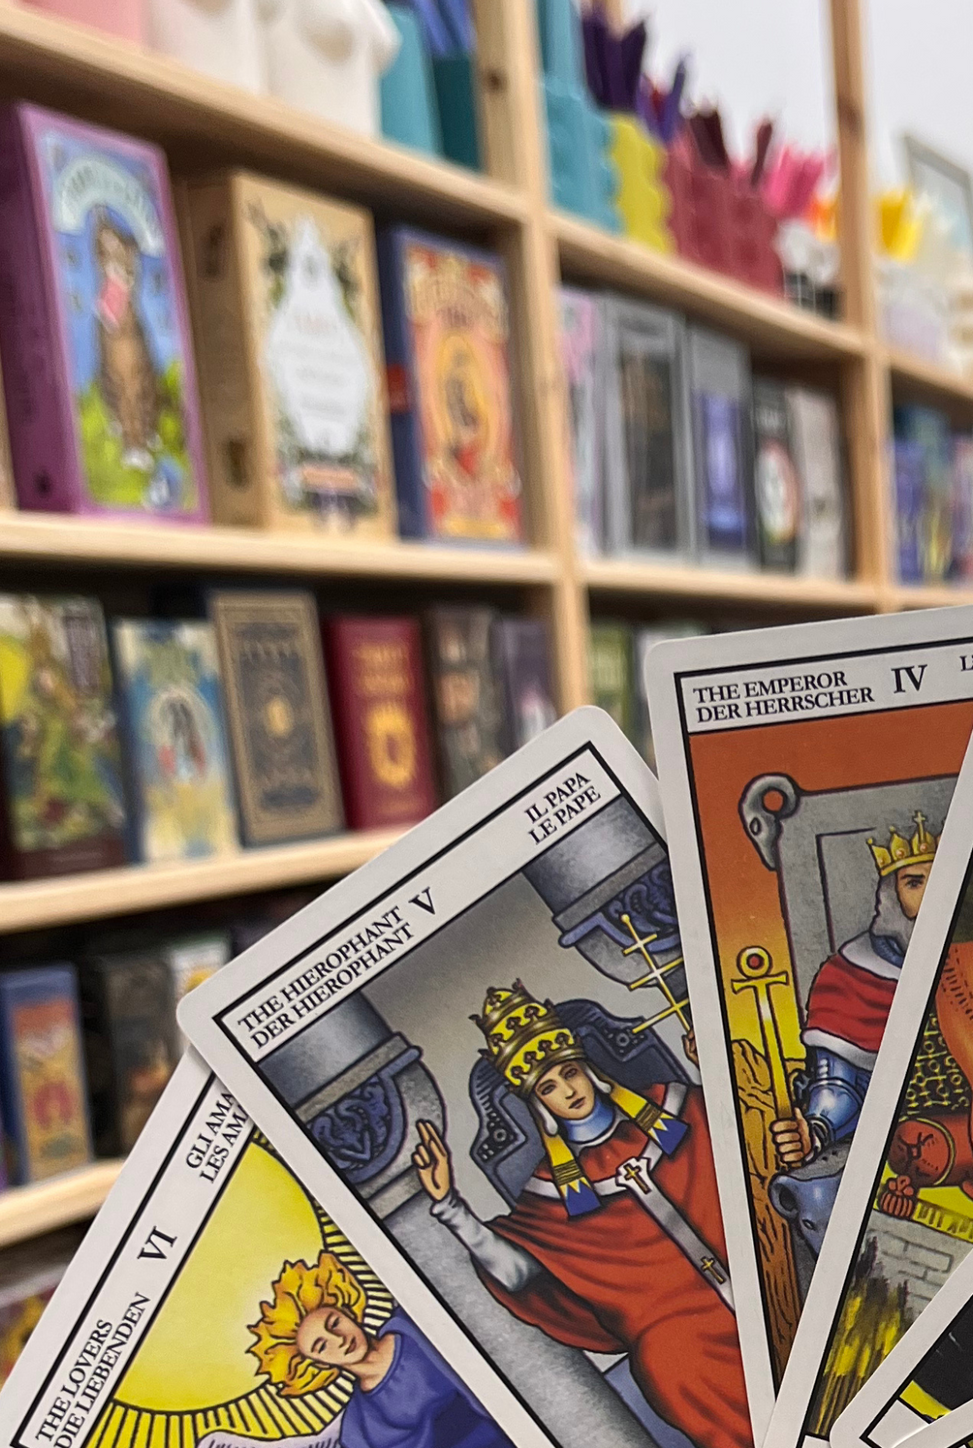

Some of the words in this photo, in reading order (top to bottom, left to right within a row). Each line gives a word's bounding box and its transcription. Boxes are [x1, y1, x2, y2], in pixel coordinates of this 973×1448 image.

[693, 684, 740, 704] THE
[744, 671, 848, 698] EMPEROR
[891, 664, 928, 694] IV
[696, 703, 742, 724] DER
[746, 687, 875, 718] HERRSCHER
[524, 802, 549, 824] IL
[543, 772, 591, 809] PAPA
[528, 818, 558, 845] LE
[553, 785, 601, 826] PAPE
[408, 886, 436, 916] V
[237, 995, 285, 1032] THE
[279, 905, 404, 1003] HIEROPHANT
[250, 1013, 297, 1049] DER
[291, 922, 414, 1020] HIEROPHANT
[186, 1133, 214, 1169] GLI
[205, 1092, 234, 1136] AMA
[199, 1145, 230, 1184] LES
[137, 1226, 178, 1260] VI
[75, 1291, 151, 1415] LIEBENDEN
[35, 1396, 70, 1442] THE
[61, 1319, 113, 1398] LOVERS
